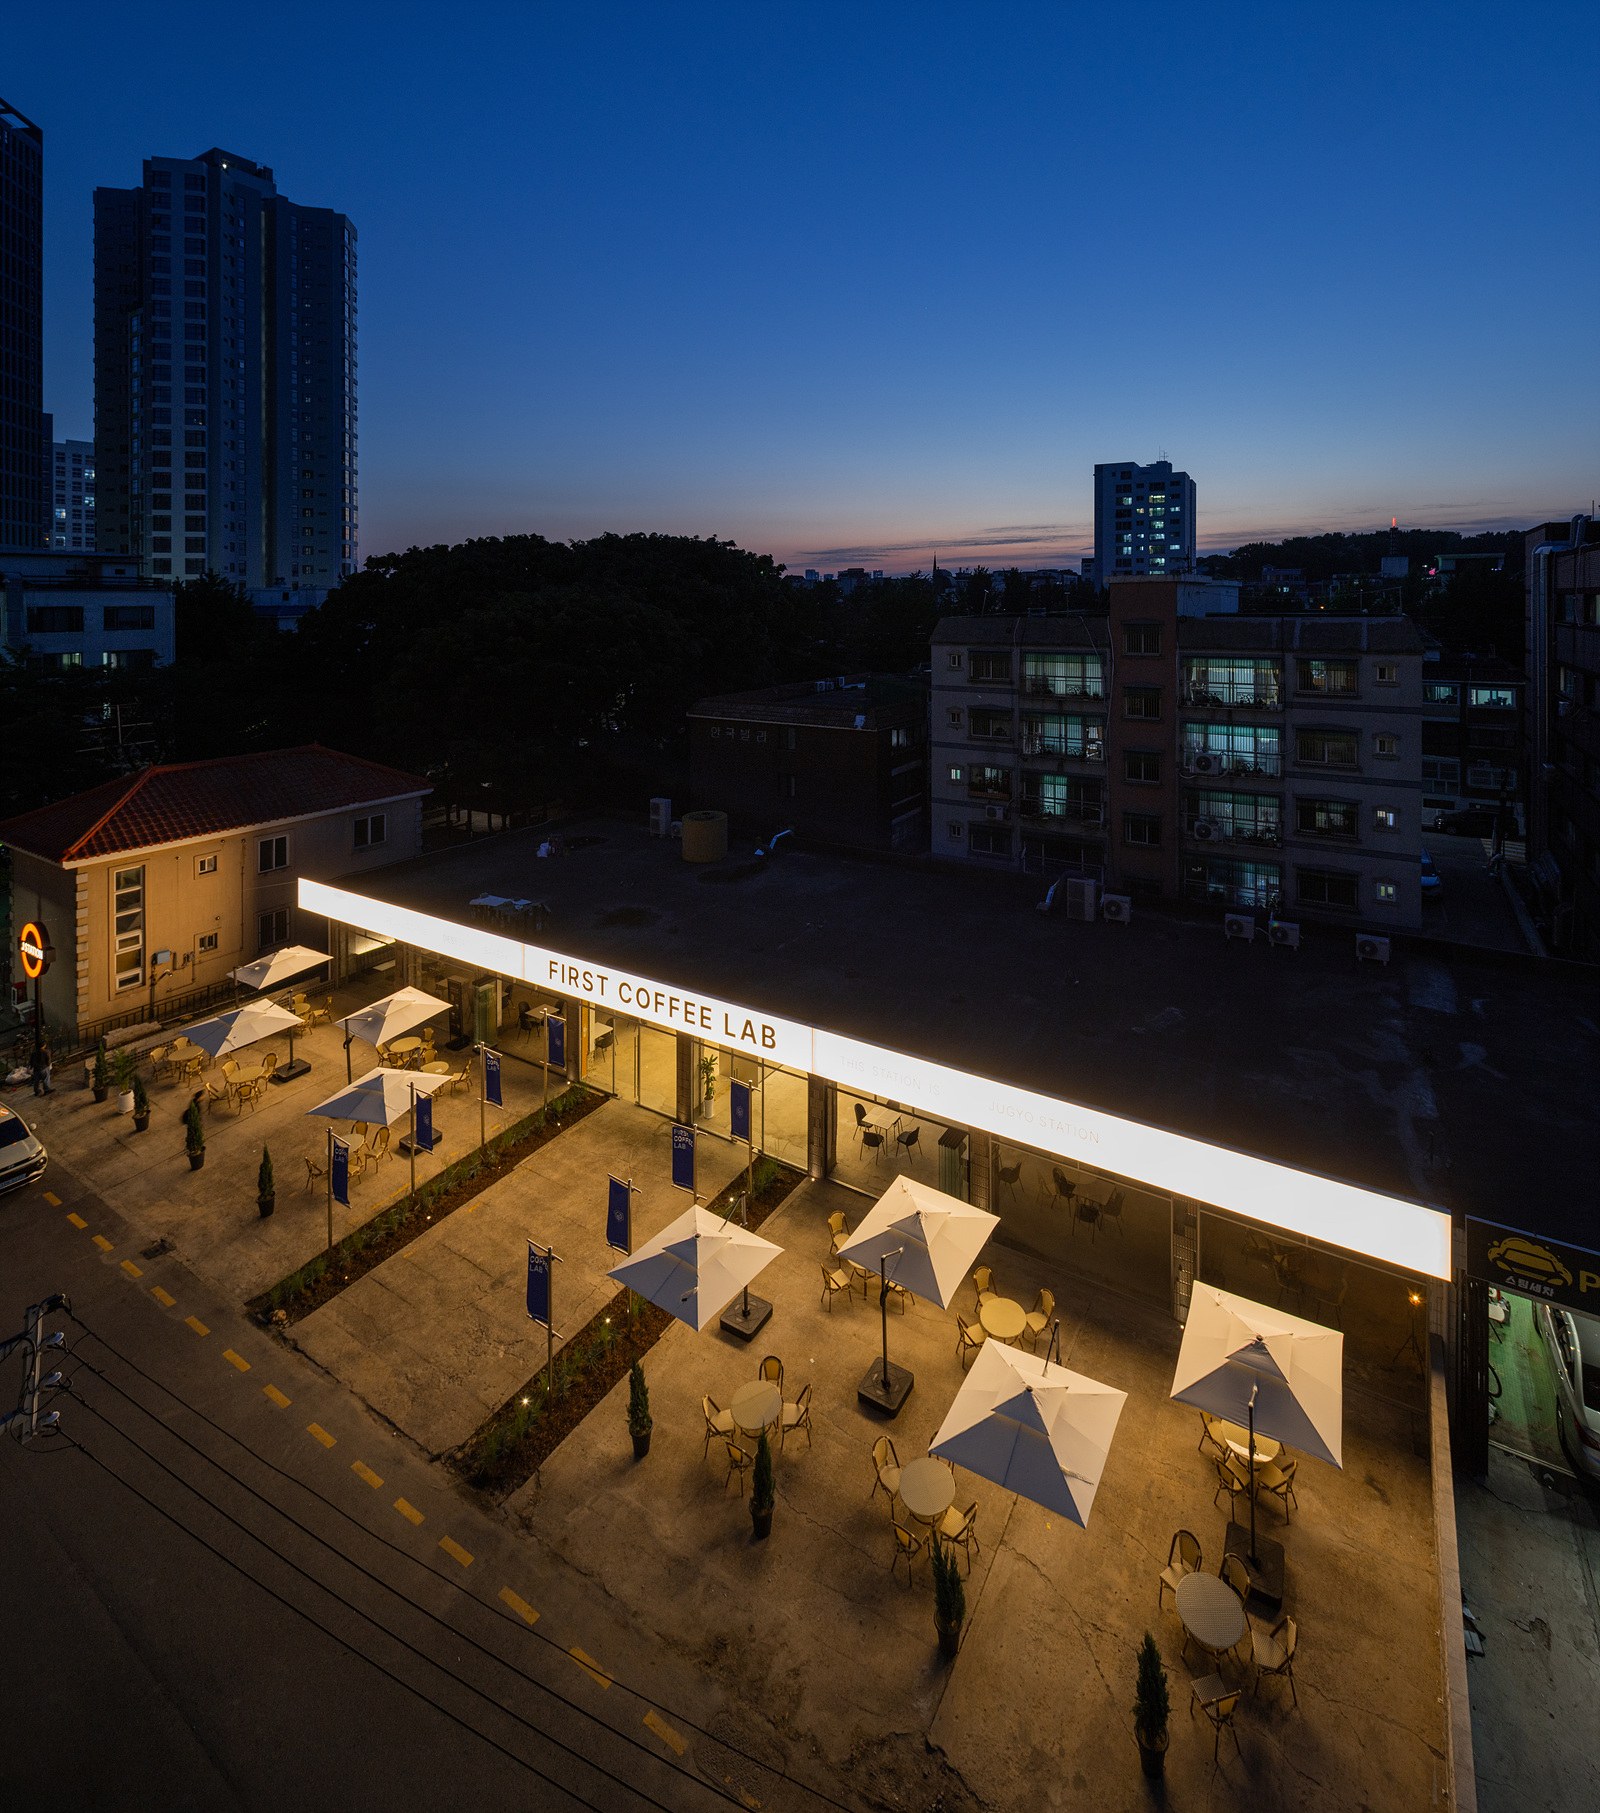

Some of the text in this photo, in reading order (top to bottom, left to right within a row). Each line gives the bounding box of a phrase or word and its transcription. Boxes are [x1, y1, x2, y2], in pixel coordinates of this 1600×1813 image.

[549, 960, 776, 1049] FIRST COFFEE LAB
[839, 1056, 865, 1072] THIS
[872, 1066, 921, 1090] STATION
[989, 1101, 1100, 1144] JUGYO STATION
[530, 1264, 543, 1273] LAB
